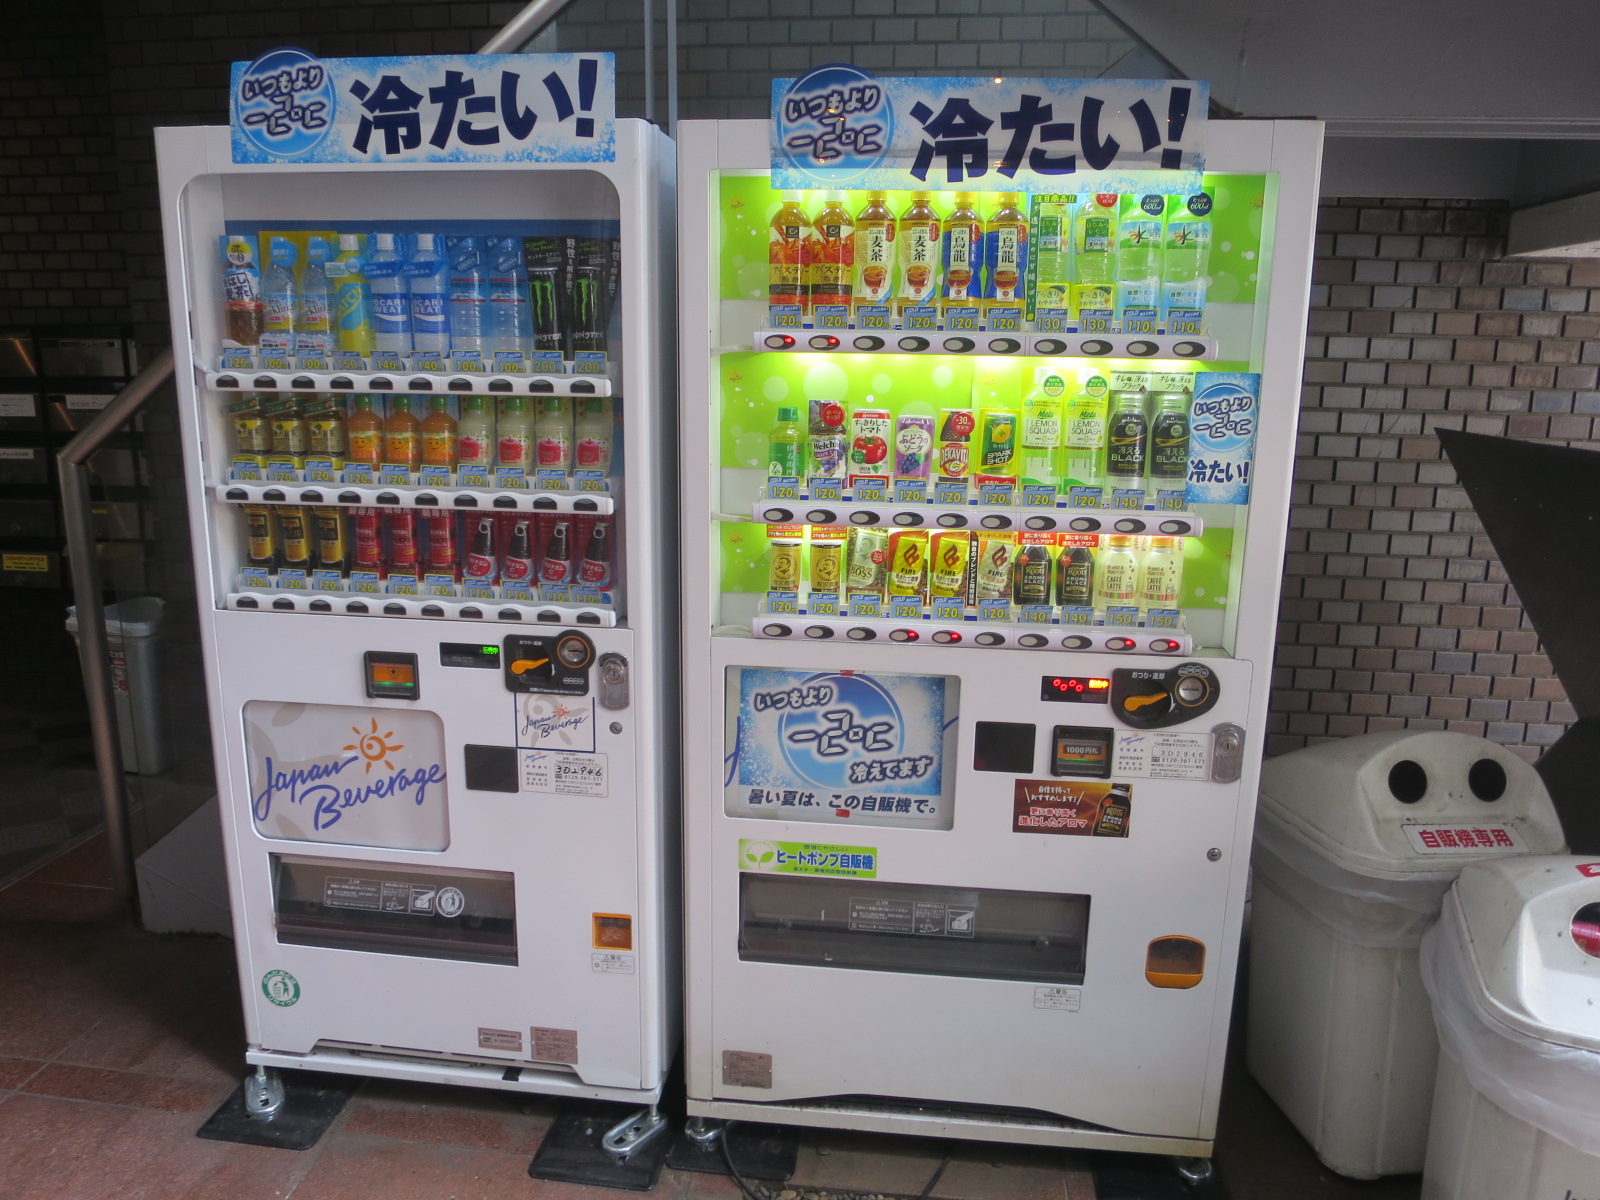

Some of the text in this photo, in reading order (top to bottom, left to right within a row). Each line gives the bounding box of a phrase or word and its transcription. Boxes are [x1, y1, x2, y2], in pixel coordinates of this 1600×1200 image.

[242, 64, 323, 101] いつもより
[785, 84, 880, 120] いつもより
[870, 235, 883, 262] 麦茶
[913, 235, 926, 262] 麦茶
[773, 266, 810, 275] アイスティー
[814, 266, 852, 275] アイスティー
[1194, 397, 1252, 416] いつもより
[1031, 420, 1057, 428] LEMON
[1073, 420, 1100, 428] LEMON
[1029, 427, 1059, 435] SQUASH
[1071, 427, 1101, 435] SQUASH
[987, 448, 1012, 459] SPARK
[1111, 454, 1144, 462] BLACK
[1156, 455, 1188, 463] BLACK
[949, 460, 961, 472] C
[987, 456, 1008, 465] SHOT
[850, 566, 873, 579] BOSS
[988, 570, 1003, 578] FIRE
[755, 685, 833, 711] いつもより
[521, 714, 557, 737] Japan
[537, 715, 589, 739] Beverage
[850, 756, 933, 783] 冷えてます
[255, 755, 359, 822] Japan
[299, 763, 447, 831] Beverage
[748, 789, 936, 813] 暑い夏は、この自販機で。
[1030, 795, 1077, 803] おすすめします!
[1030, 807, 1076, 817] 更に香り高く
[1018, 815, 1088, 828] 進化したアロマ
[1418, 828, 1514, 849] 自販機専用
[777, 850, 874, 870] ヒートポンプ自販機
